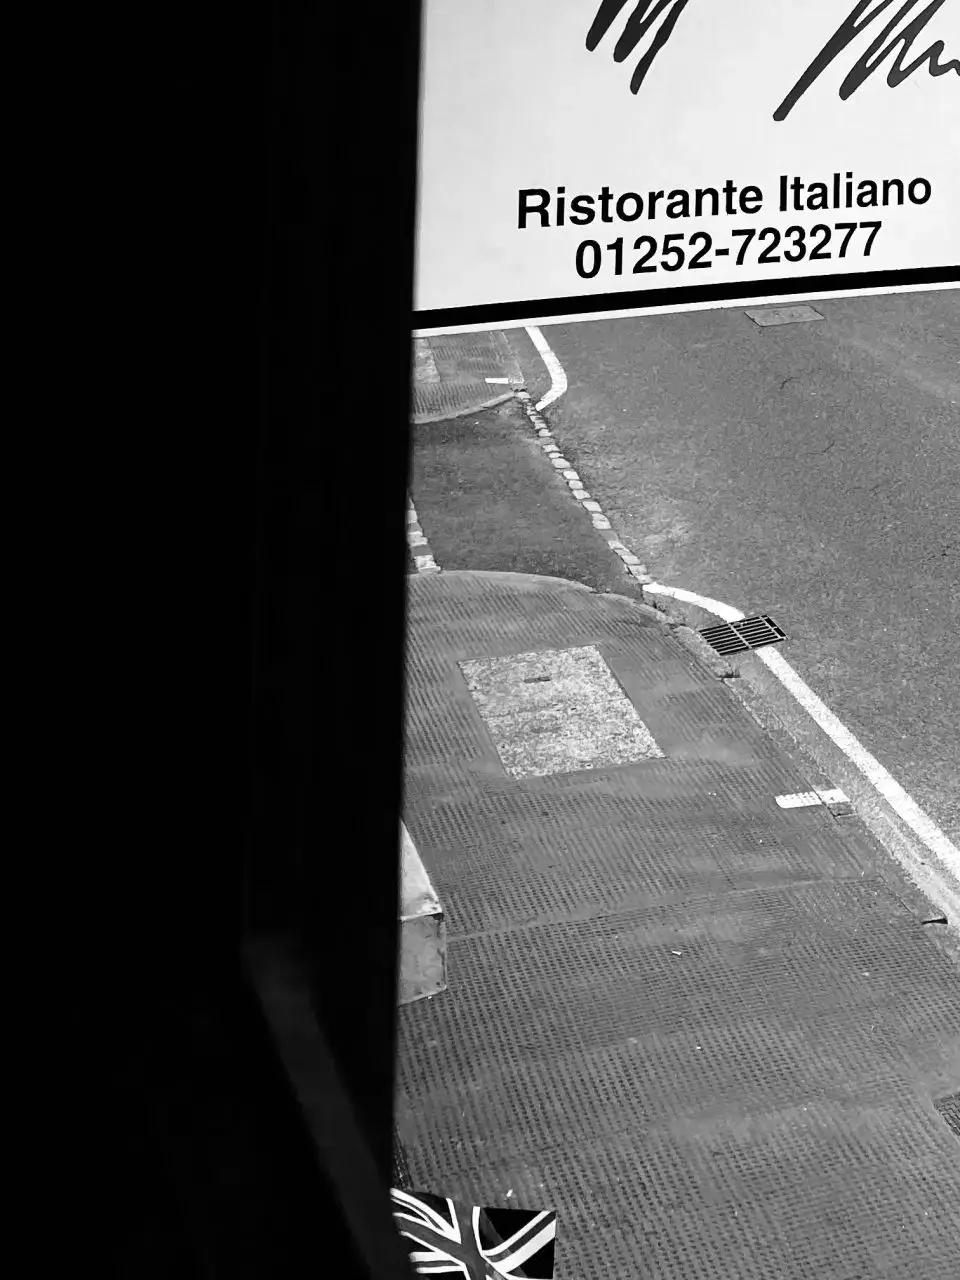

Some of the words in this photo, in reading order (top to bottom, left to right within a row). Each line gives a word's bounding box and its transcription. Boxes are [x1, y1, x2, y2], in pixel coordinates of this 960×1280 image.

[517, 179, 763, 229] Ristorante
[779, 172, 932, 212] Italiano
[575, 220, 882, 279] 01252-723277
